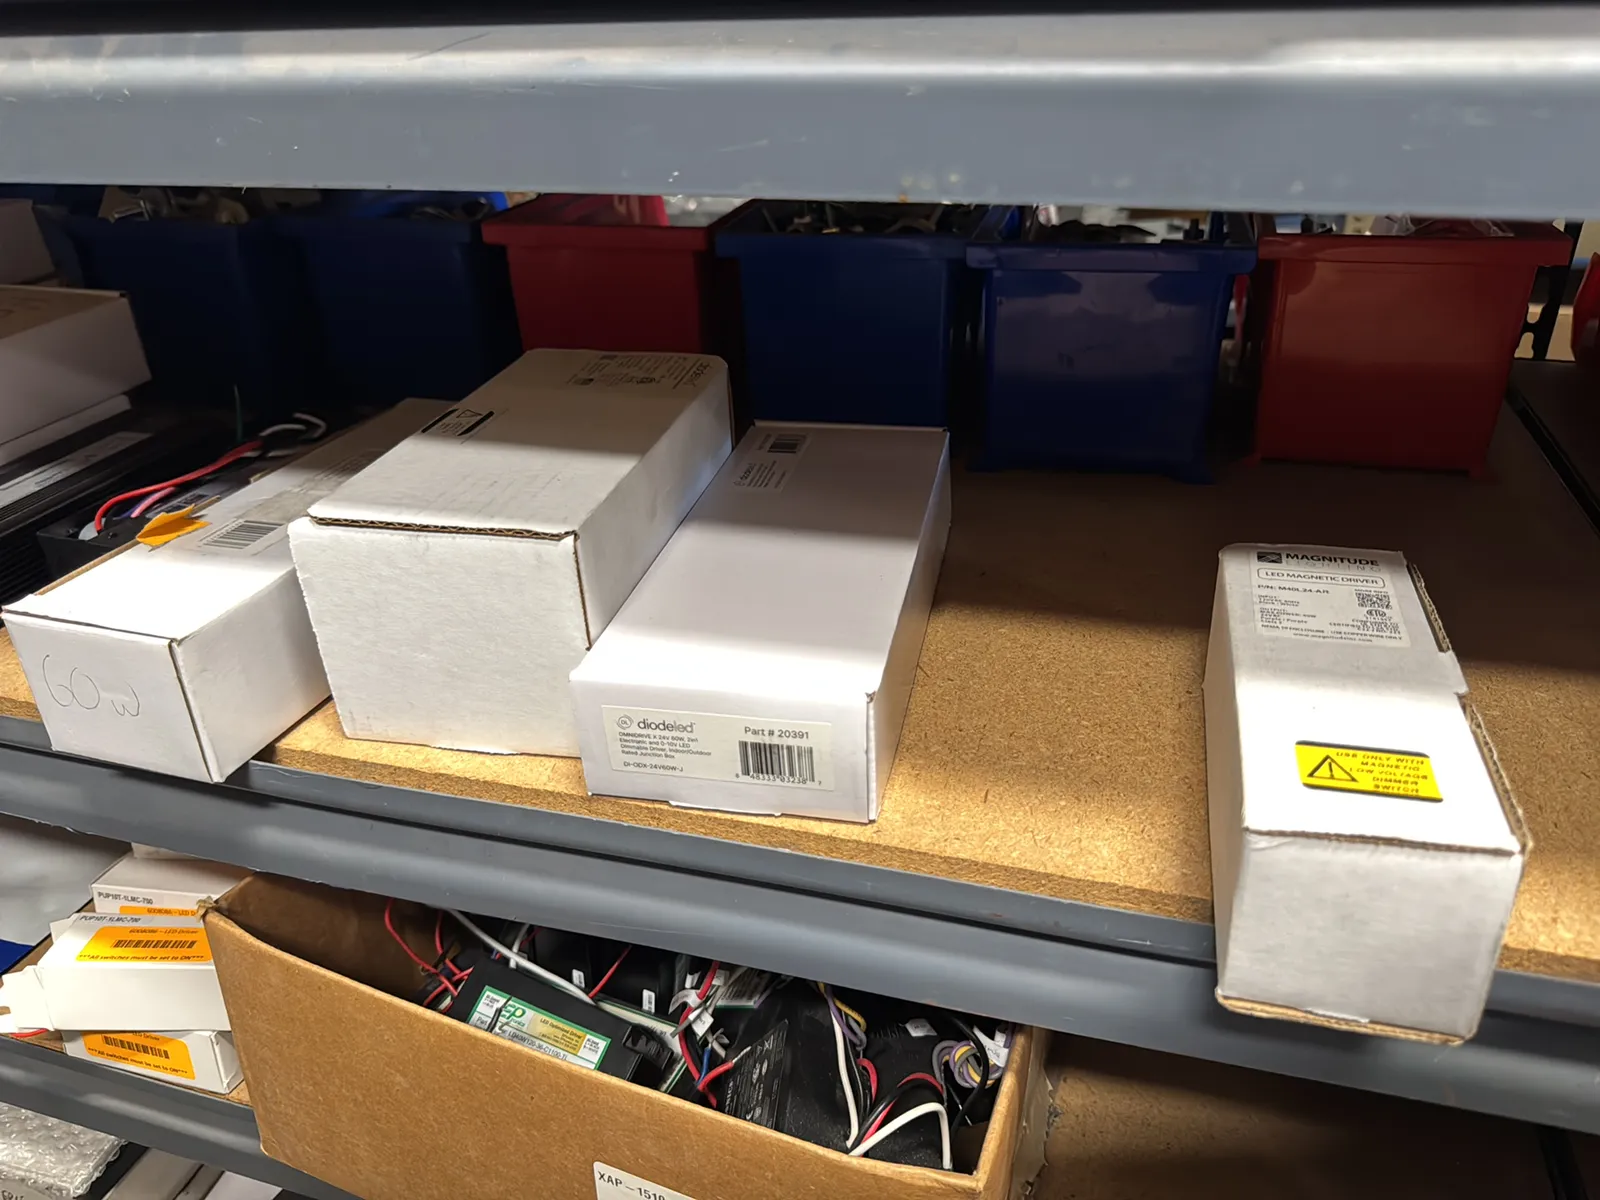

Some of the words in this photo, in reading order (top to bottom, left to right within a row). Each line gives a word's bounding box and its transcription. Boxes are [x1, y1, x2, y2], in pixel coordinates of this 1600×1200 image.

[1285, 552, 1380, 567] MAGNITUDE
[1286, 573, 1340, 582] MAGNETIC
[1341, 577, 1379, 585] DRIVER
[637, 718, 694, 734] diodeled
[744, 726, 766, 736] Part
[768, 729, 775, 737] #
[777, 729, 809, 739] 20391
[1362, 754, 1391, 762] ONLY
[1395, 757, 1425, 765] WITH
